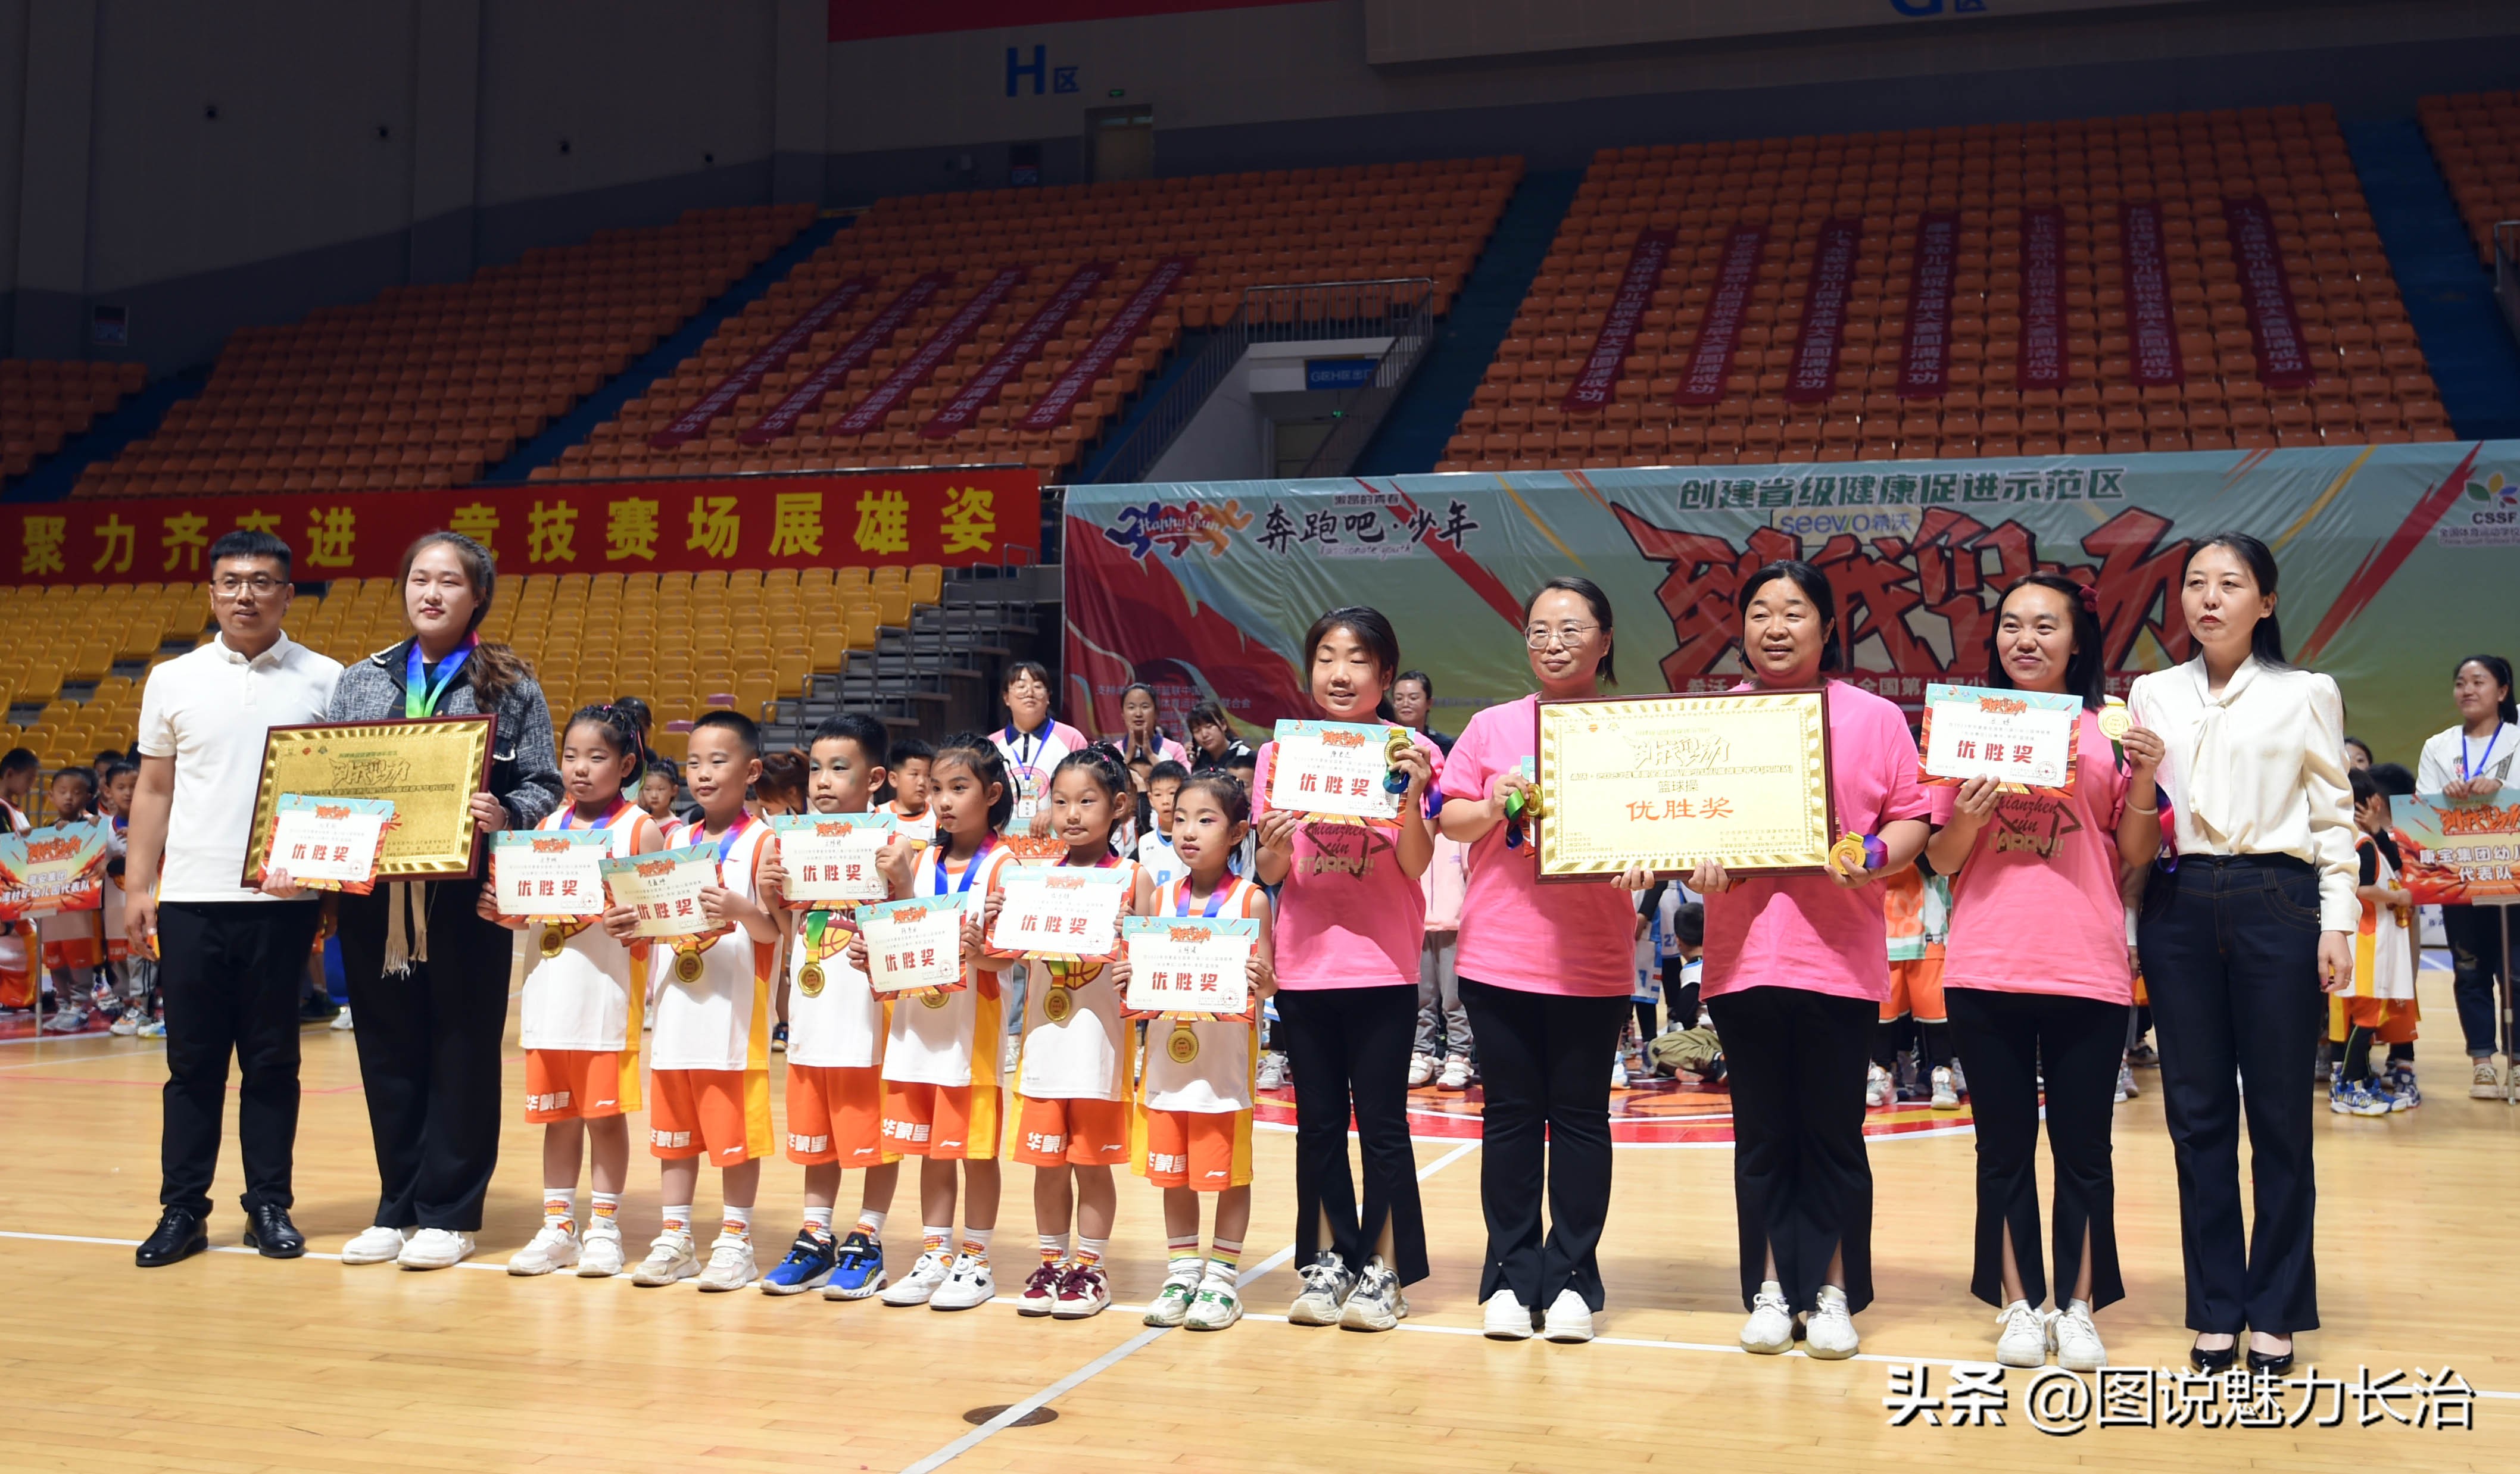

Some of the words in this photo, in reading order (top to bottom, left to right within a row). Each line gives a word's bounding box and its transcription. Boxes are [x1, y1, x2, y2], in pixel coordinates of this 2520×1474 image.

[1677, 467, 2125, 511] 创建省级健康促进示范区
[451, 487, 996, 564] 竞技赛场展雄姿
[1136, 516, 1187, 537] Happy
[1189, 511, 1220, 532] Run
[1256, 499, 1479, 555] 奔跑吧·少年
[1874, 513, 1910, 532] 希沃
[2472, 511, 2518, 524] CSSF
[1958, 740, 2034, 764] 优胜奖
[1300, 773, 1370, 797] 优胜奖
[1657, 779, 1699, 794] 篮球操
[1626, 797, 1734, 821] 优胜奖
[291, 843, 350, 863] 优胜奖
[803, 864, 862, 882] 优胜奖
[2458, 867, 2513, 882] 代表队
[517, 879, 578, 897] 优胜奖
[637, 898, 694, 920] 优胜奖
[1021, 914, 1088, 935] 优胜奖
[885, 948, 935, 972] 优胜奖
[1152, 971, 1218, 992] 优胜奖
[882, 1117, 930, 1143] 华蒙星
